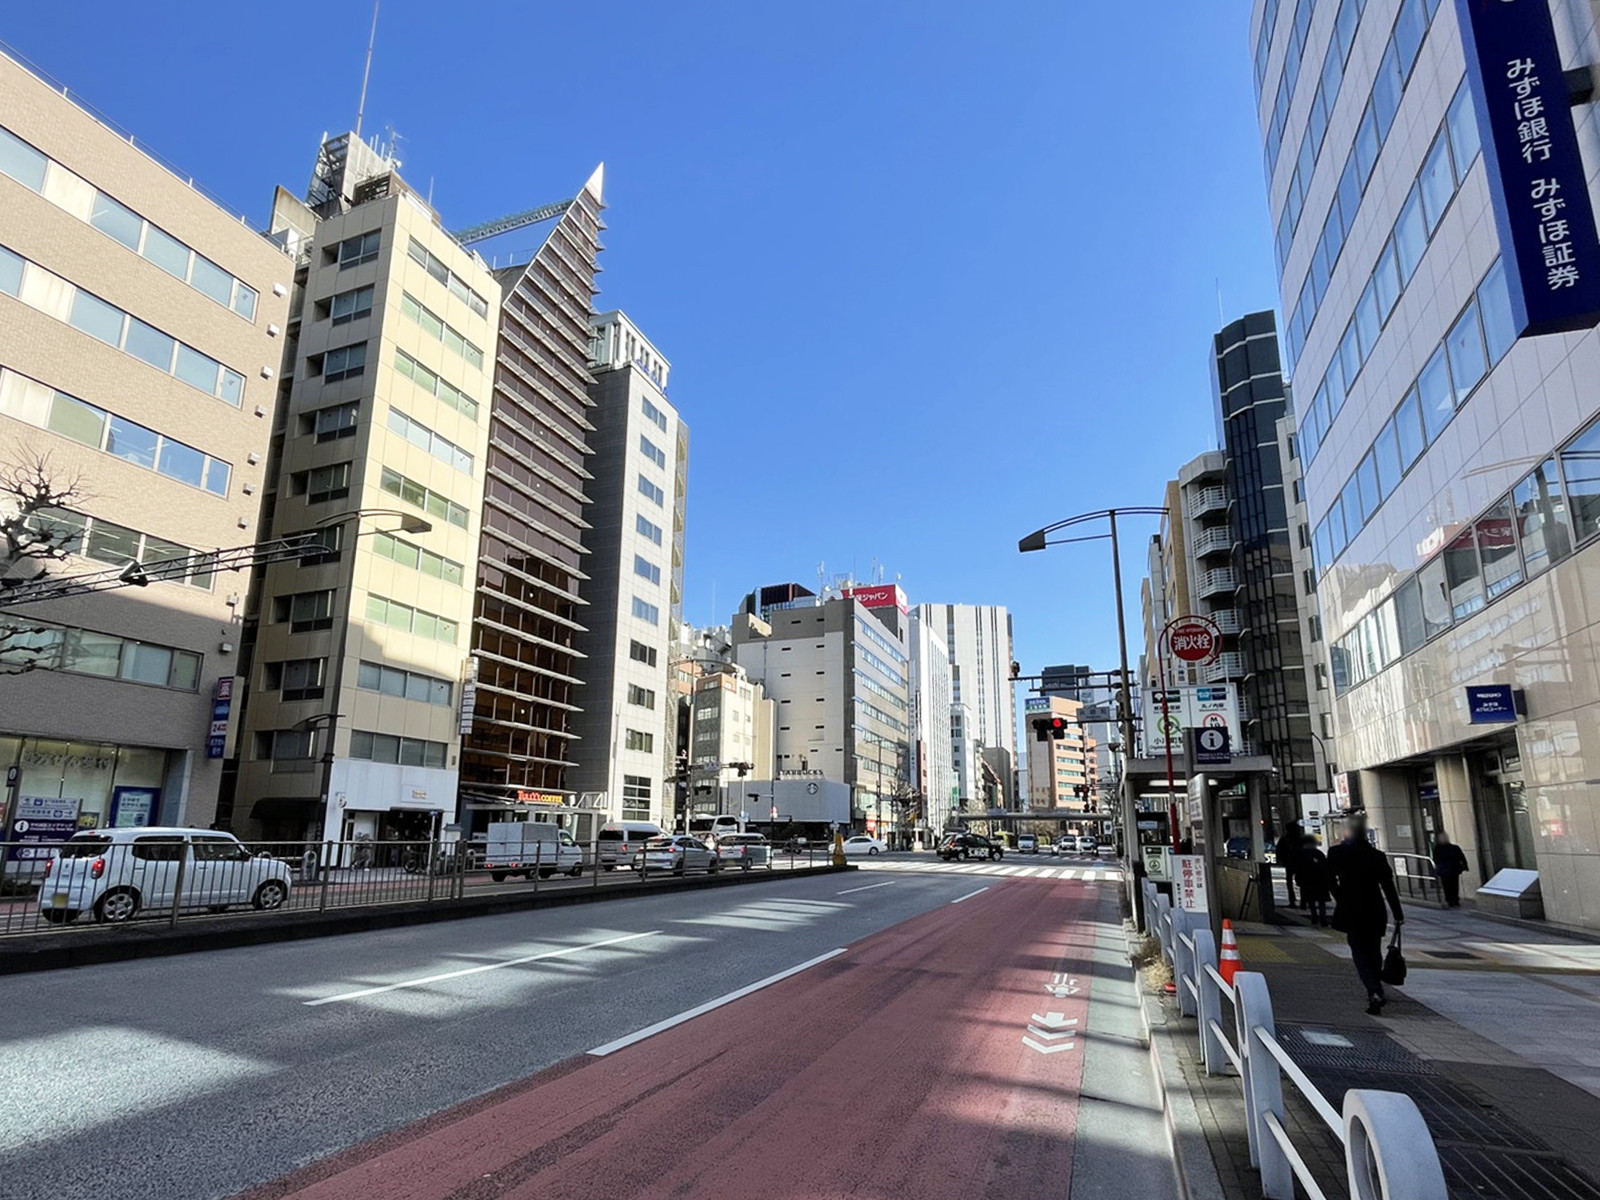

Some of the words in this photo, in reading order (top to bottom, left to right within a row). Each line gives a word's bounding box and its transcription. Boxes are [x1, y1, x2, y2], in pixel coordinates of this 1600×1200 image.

[1506, 57, 1553, 164] みずほ銀行
[1530, 178, 1580, 291] みずほ証券
[1174, 633, 1211, 651] 消火栓
